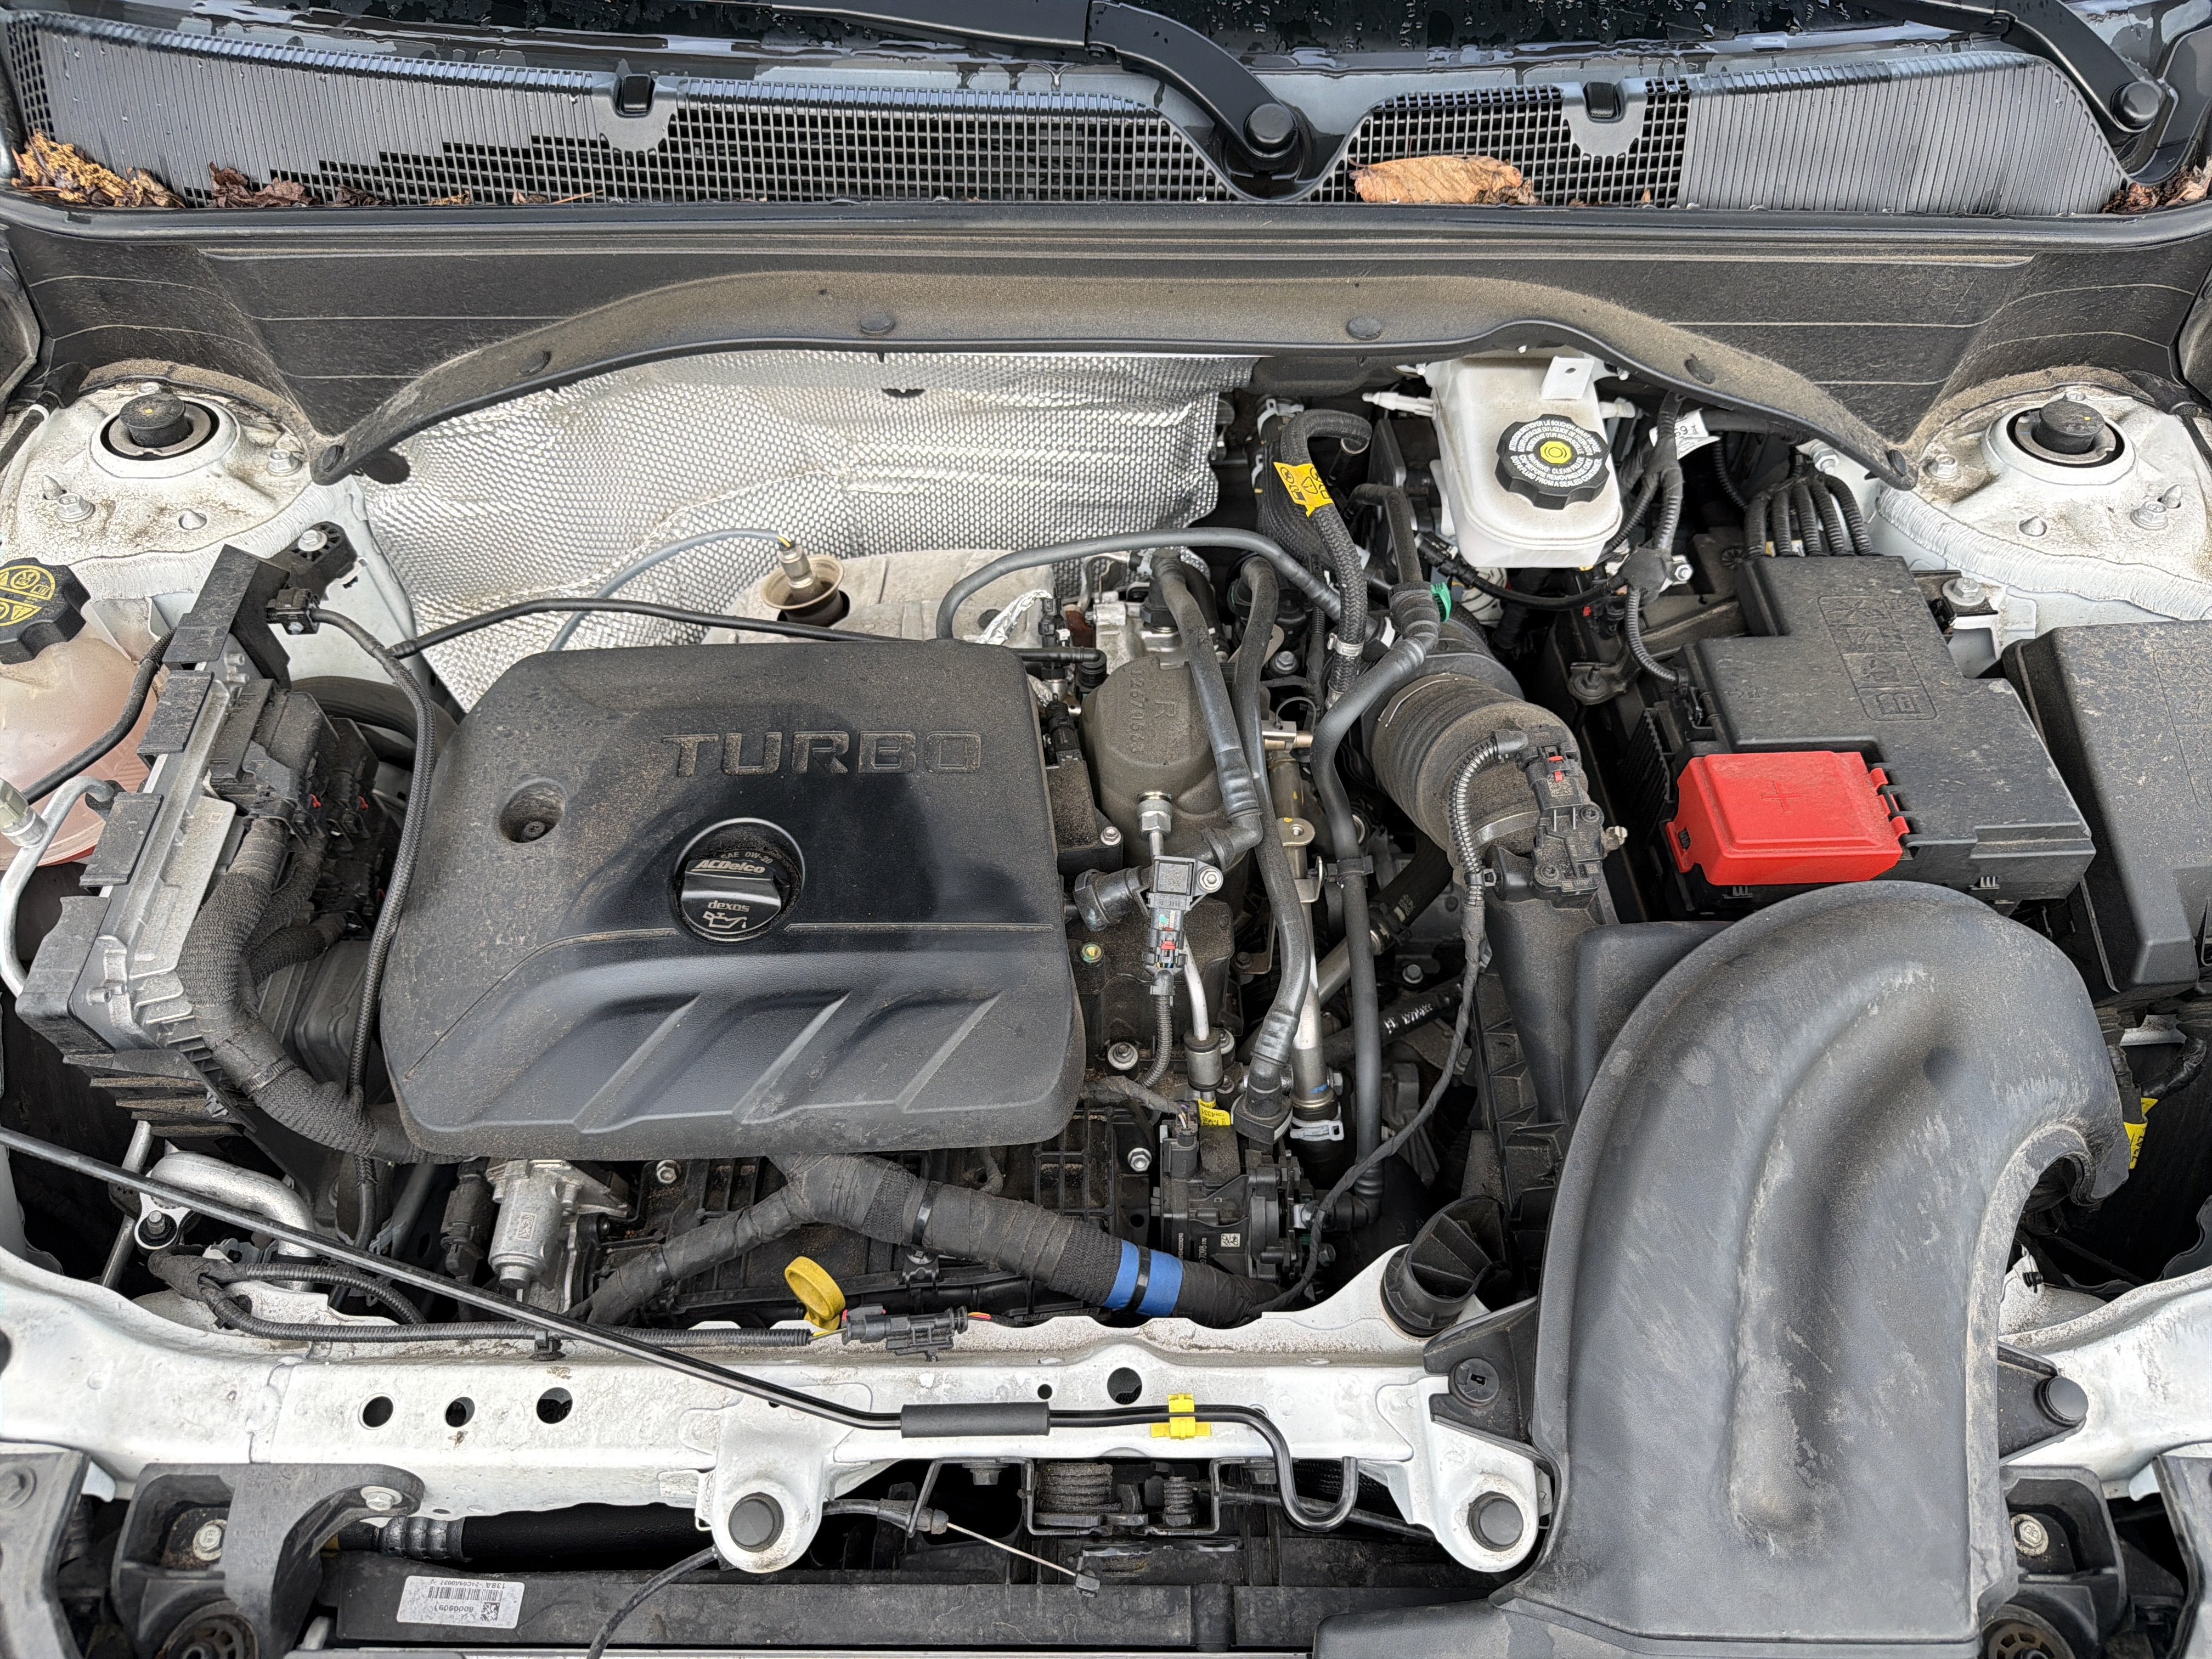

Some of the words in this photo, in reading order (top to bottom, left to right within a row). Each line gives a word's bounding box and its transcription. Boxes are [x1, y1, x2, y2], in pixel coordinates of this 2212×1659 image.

[1525, 464, 1547, 478] BEFORE
[1551, 466, 1572, 475] CLEAN
[1571, 456, 1585, 471] FILLER
[1520, 466, 1536, 479] FLUID
[1535, 477, 1554, 486] FROM
[1559, 479, 1583, 487] SEALED
[1154, 699, 1177, 718] R
[662, 731, 982, 777] TURBO
[745, 851, 774, 864] 0W-20
[694, 860, 766, 874] ACDelco
[708, 900, 752, 913] dexos
